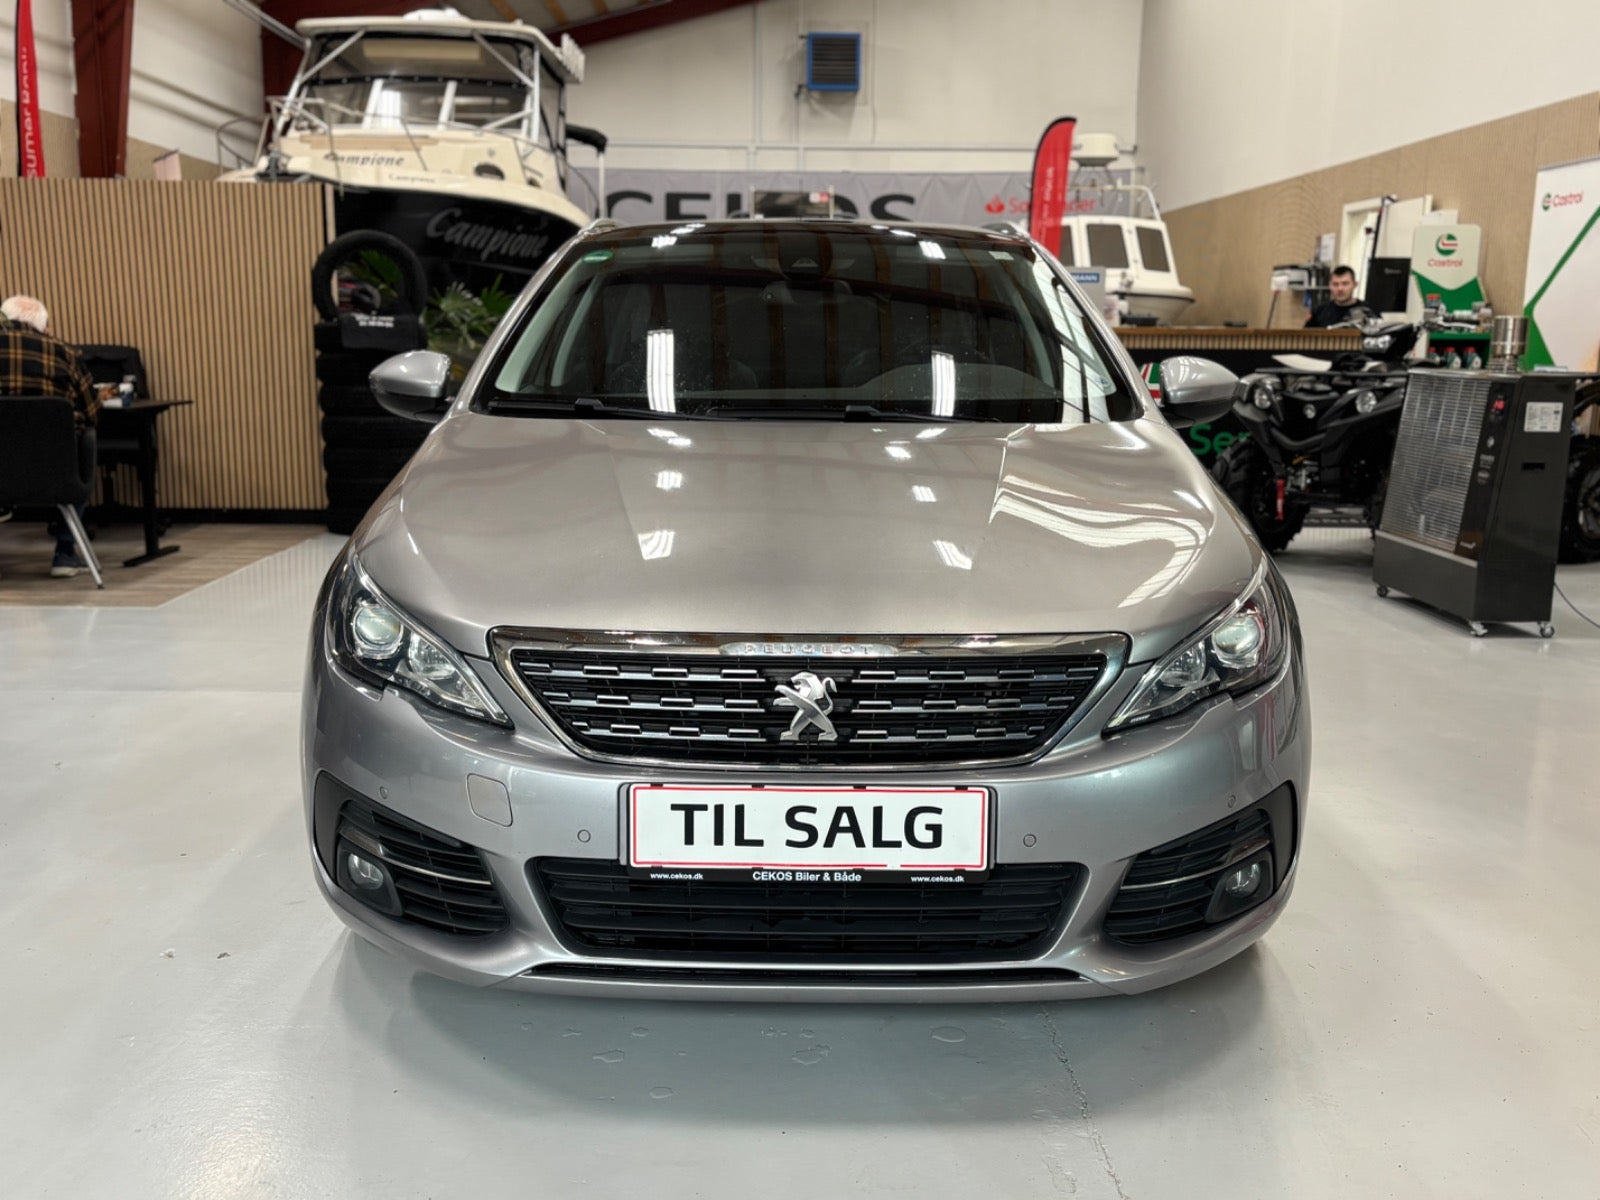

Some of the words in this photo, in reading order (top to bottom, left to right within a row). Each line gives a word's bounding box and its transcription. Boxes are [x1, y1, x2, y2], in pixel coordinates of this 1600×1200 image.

[1427, 257, 1464, 267] Castrol
[744, 644, 874, 655] PEUGEOT
[670, 803, 765, 848] TIL
[784, 804, 943, 850] SALG
[649, 872, 704, 881] www.cekos.dk
[752, 871, 793, 882] CEKOS
[795, 871, 820, 882] Biler
[822, 872, 831, 882] &
[833, 871, 862, 882] Både
[910, 874, 965, 883] www.cekos.dk
